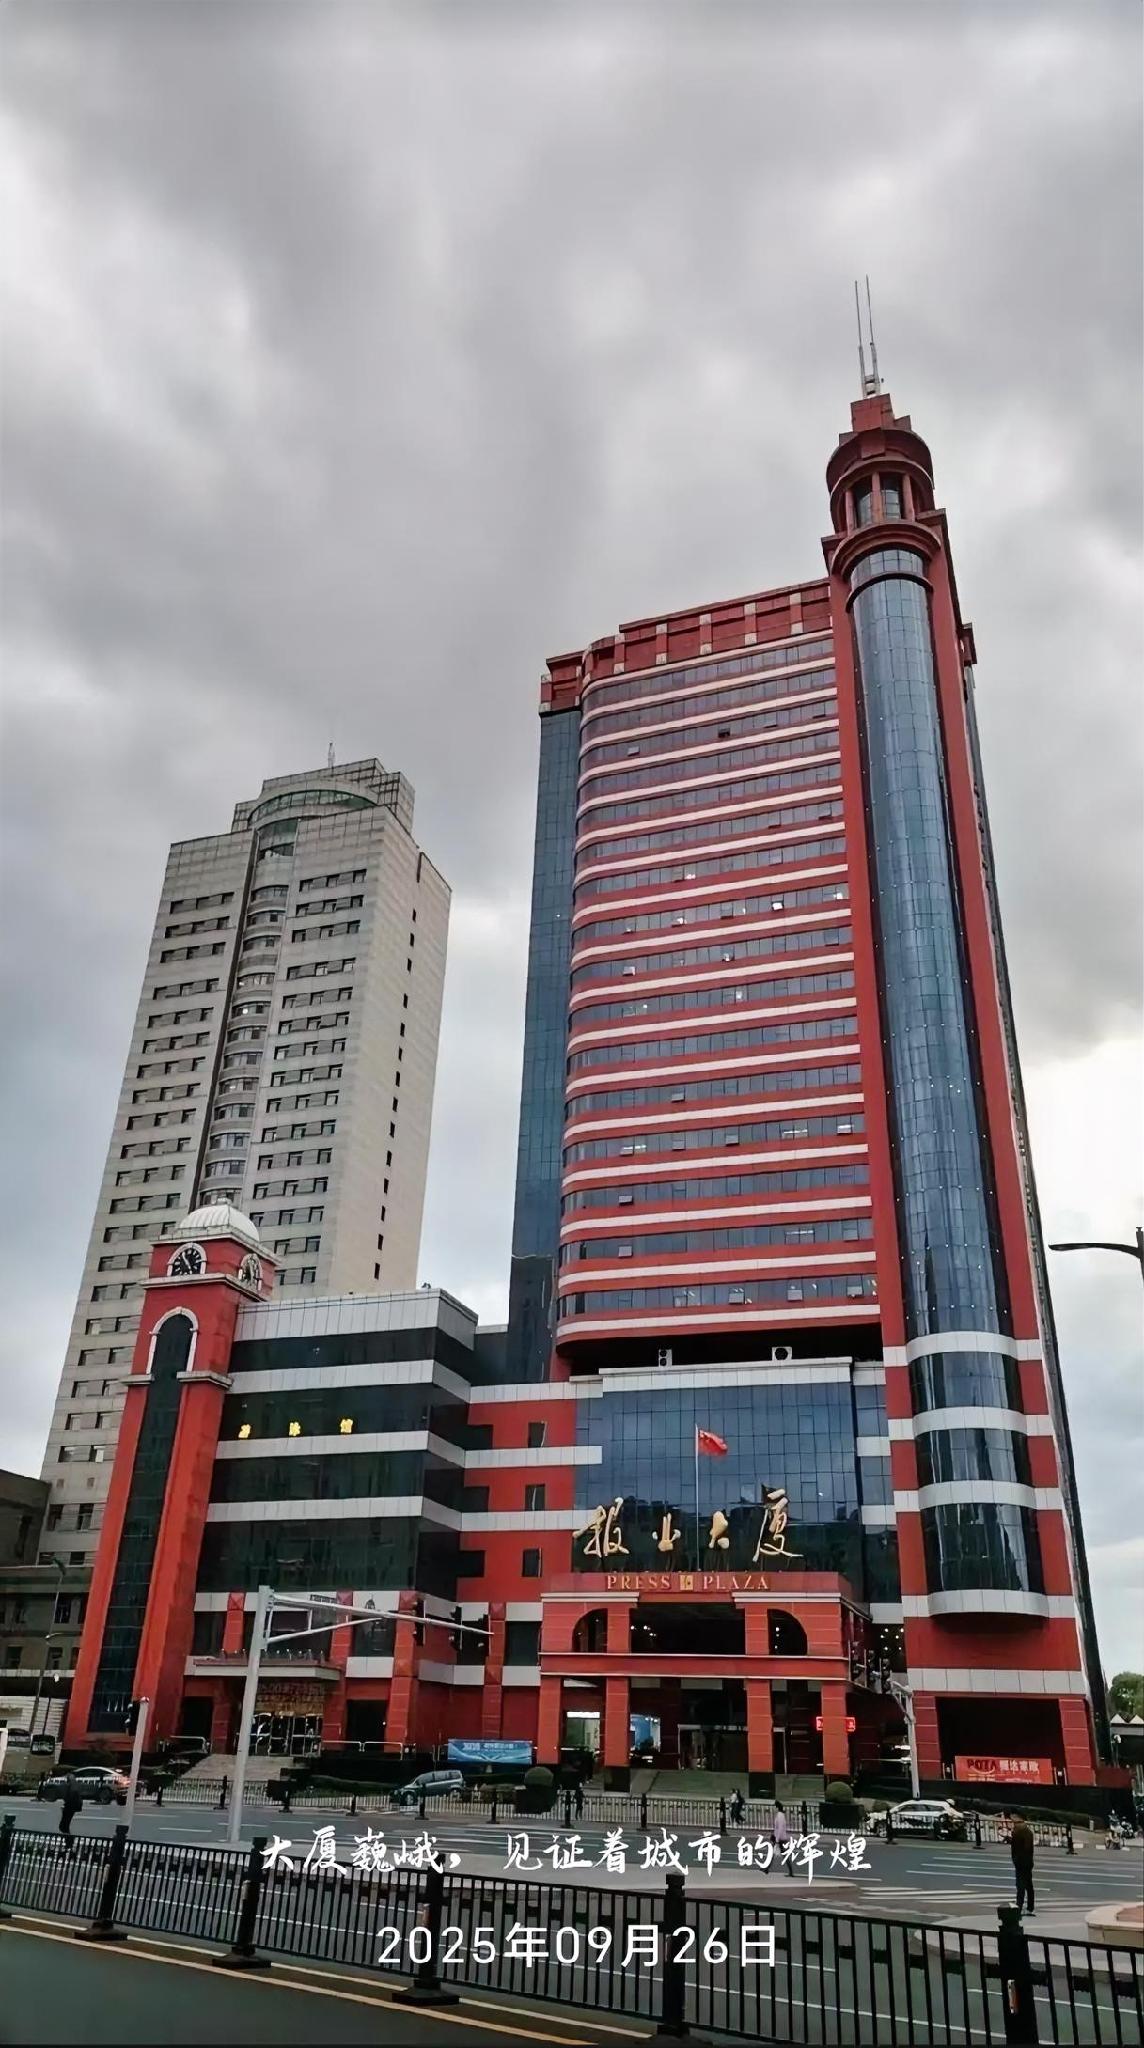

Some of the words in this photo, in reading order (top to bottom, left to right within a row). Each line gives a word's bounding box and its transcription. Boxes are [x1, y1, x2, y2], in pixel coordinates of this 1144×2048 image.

[573, 1489, 803, 1562] 报业大厦
[607, 1576, 671, 1590] PRESS
[703, 1576, 769, 1590] PLAZA
